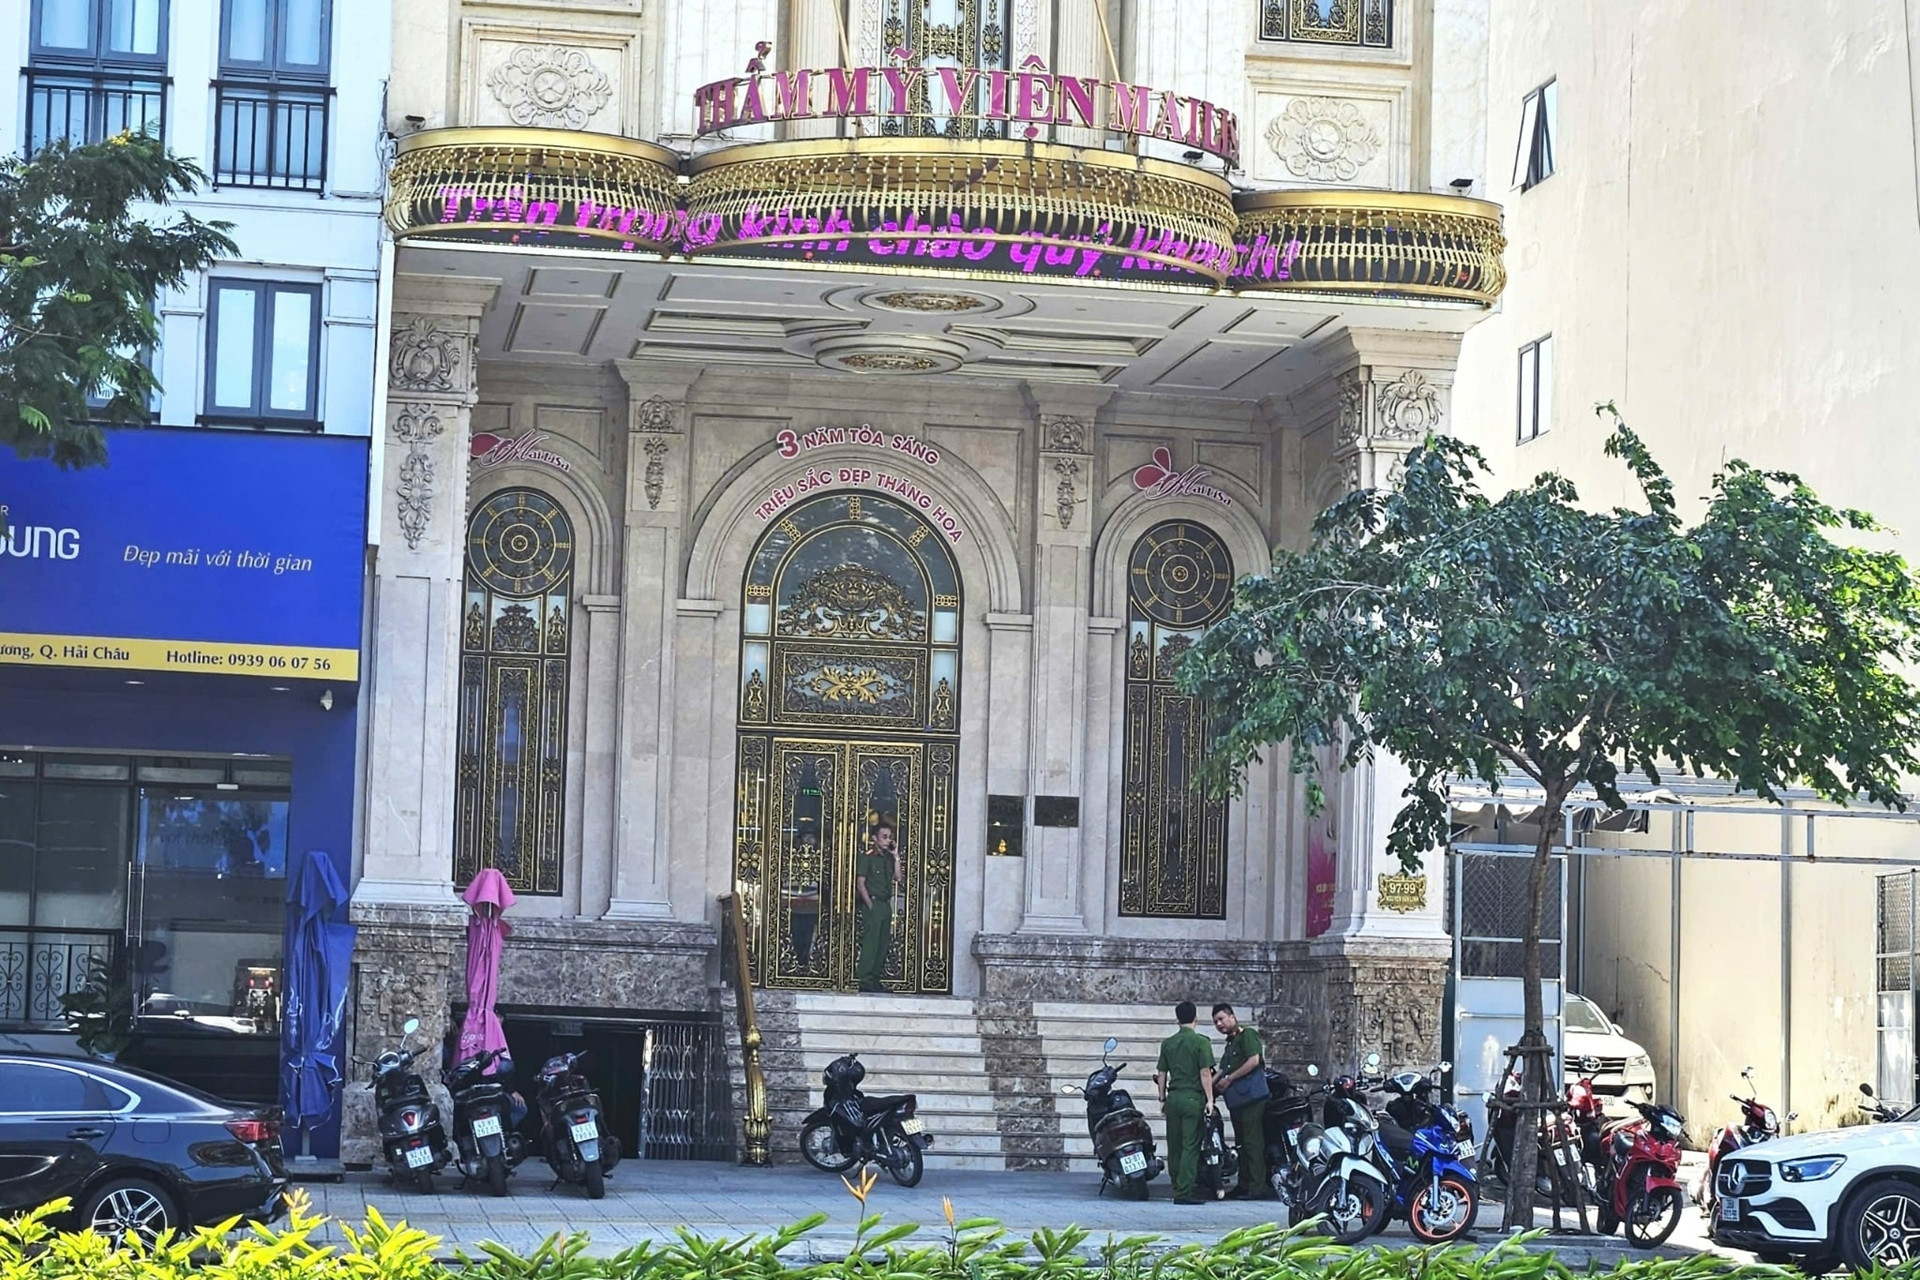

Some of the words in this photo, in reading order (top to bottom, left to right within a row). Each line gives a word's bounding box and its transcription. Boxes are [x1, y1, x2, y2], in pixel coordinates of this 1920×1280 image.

[694, 40, 813, 135] THẨM
[821, 46, 923, 117] MỸ
[935, 54, 1099, 139] VIỆN
[868, 212, 996, 261] chào
[1009, 222, 1113, 276] quý
[778, 430, 799, 458] 3
[803, 428, 844, 449] NĂM
[849, 424, 884, 446] TỎA
[892, 434, 939, 464] SÁNG
[754, 485, 795, 521] TRIỆU
[797, 468, 833, 493] SẮC
[839, 468, 871, 486] ĐẸP
[876, 473, 932, 509] THĂNG
[932, 506, 964, 542] HOA
[123, 545, 160, 568] Đẹp
[166, 548, 200, 565] mãi
[206, 549, 232, 567] với
[237, 550, 270, 569] thời
[273, 553, 312, 575] gian
[39, 644, 58, 659] Q.
[63, 644, 88, 659] Hải
[93, 646, 130, 661] Châu
[166, 650, 223, 665] Hotline:
[228, 653, 264, 667] 0939
[269, 656, 286, 668] 06
[291, 657, 309, 669] 07
[313, 658, 331, 671] 56
[1389, 882, 1416, 894] 97-99
